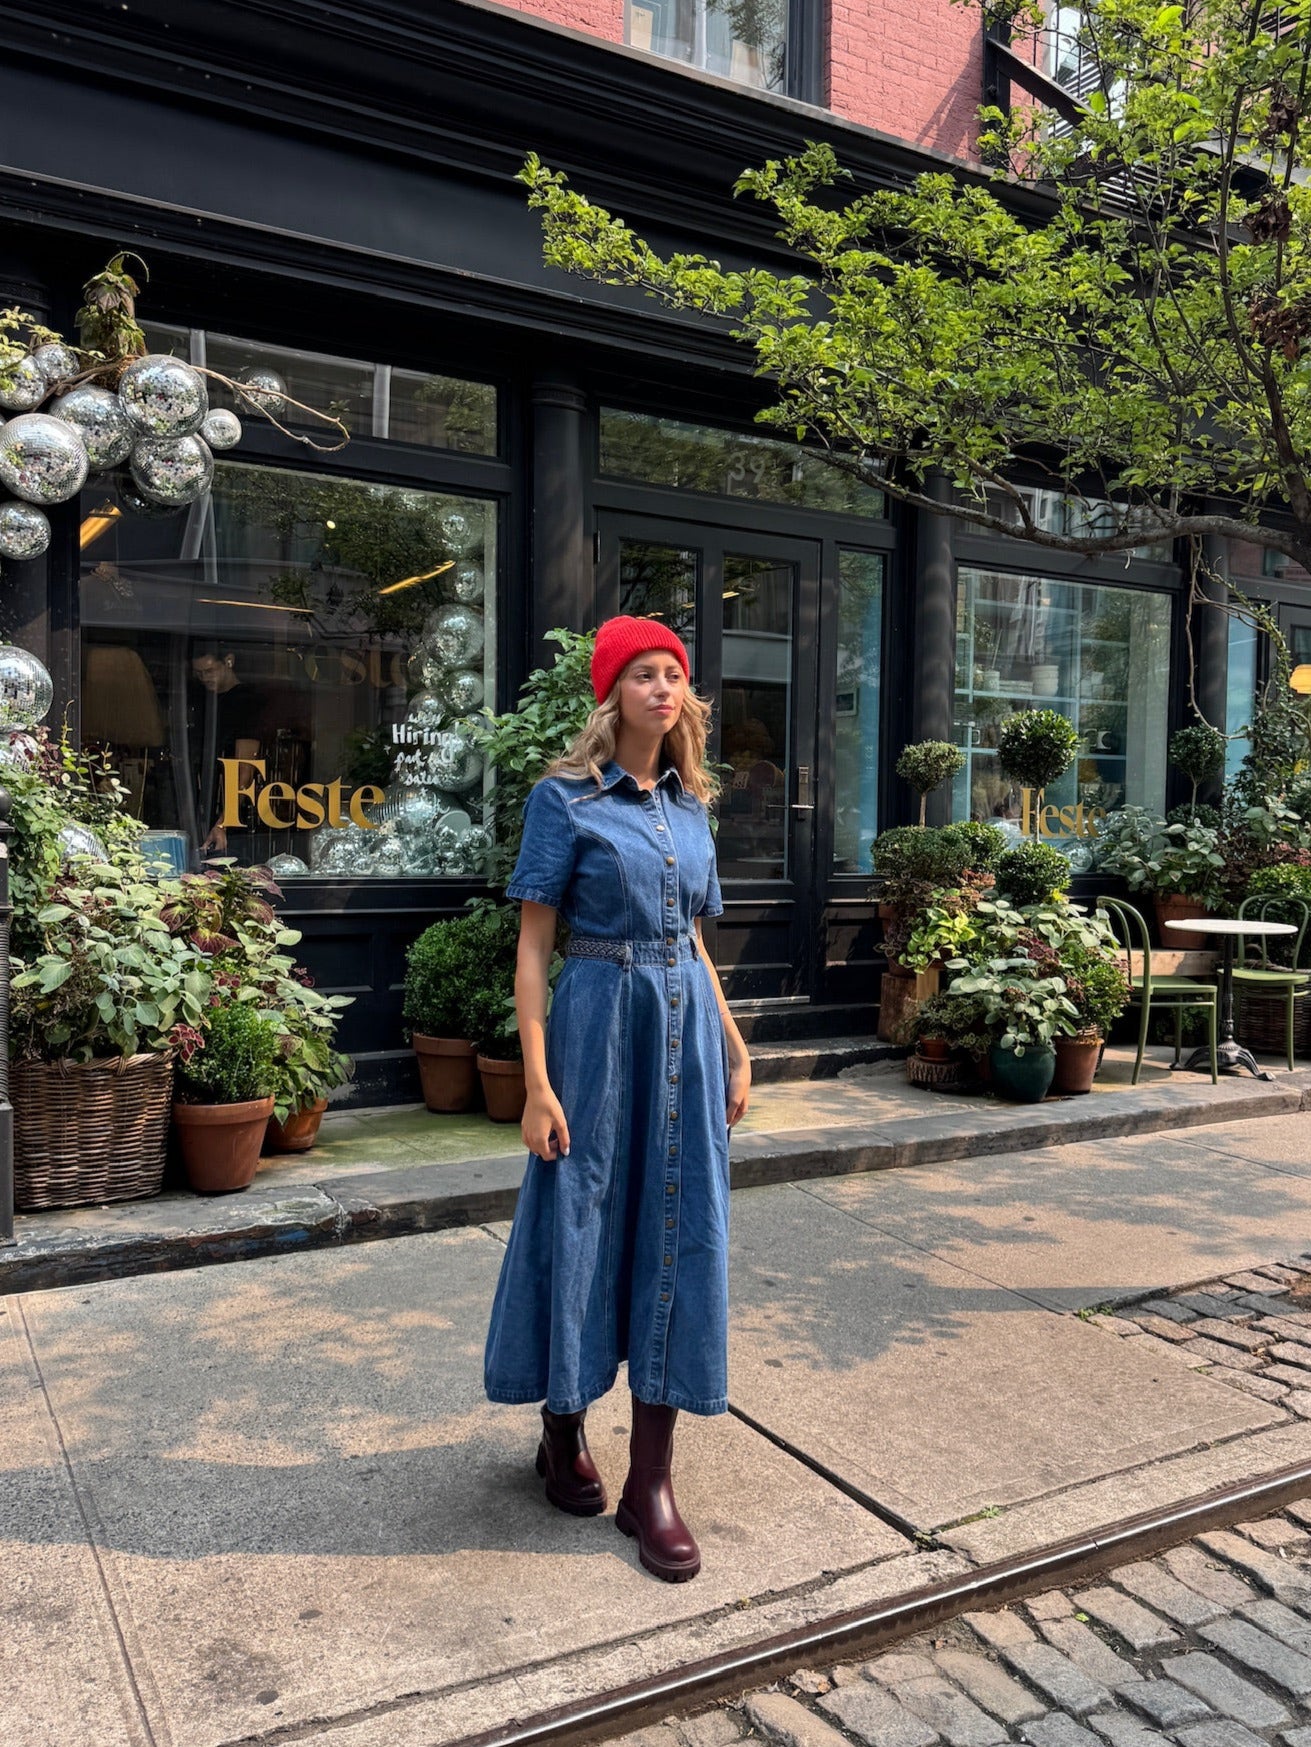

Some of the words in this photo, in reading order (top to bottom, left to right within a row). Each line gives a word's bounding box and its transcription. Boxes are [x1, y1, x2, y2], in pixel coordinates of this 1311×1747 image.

[728, 451, 766, 484] 39
[217, 758, 386, 830] Feste
[1021, 787, 1106, 838] Feste
